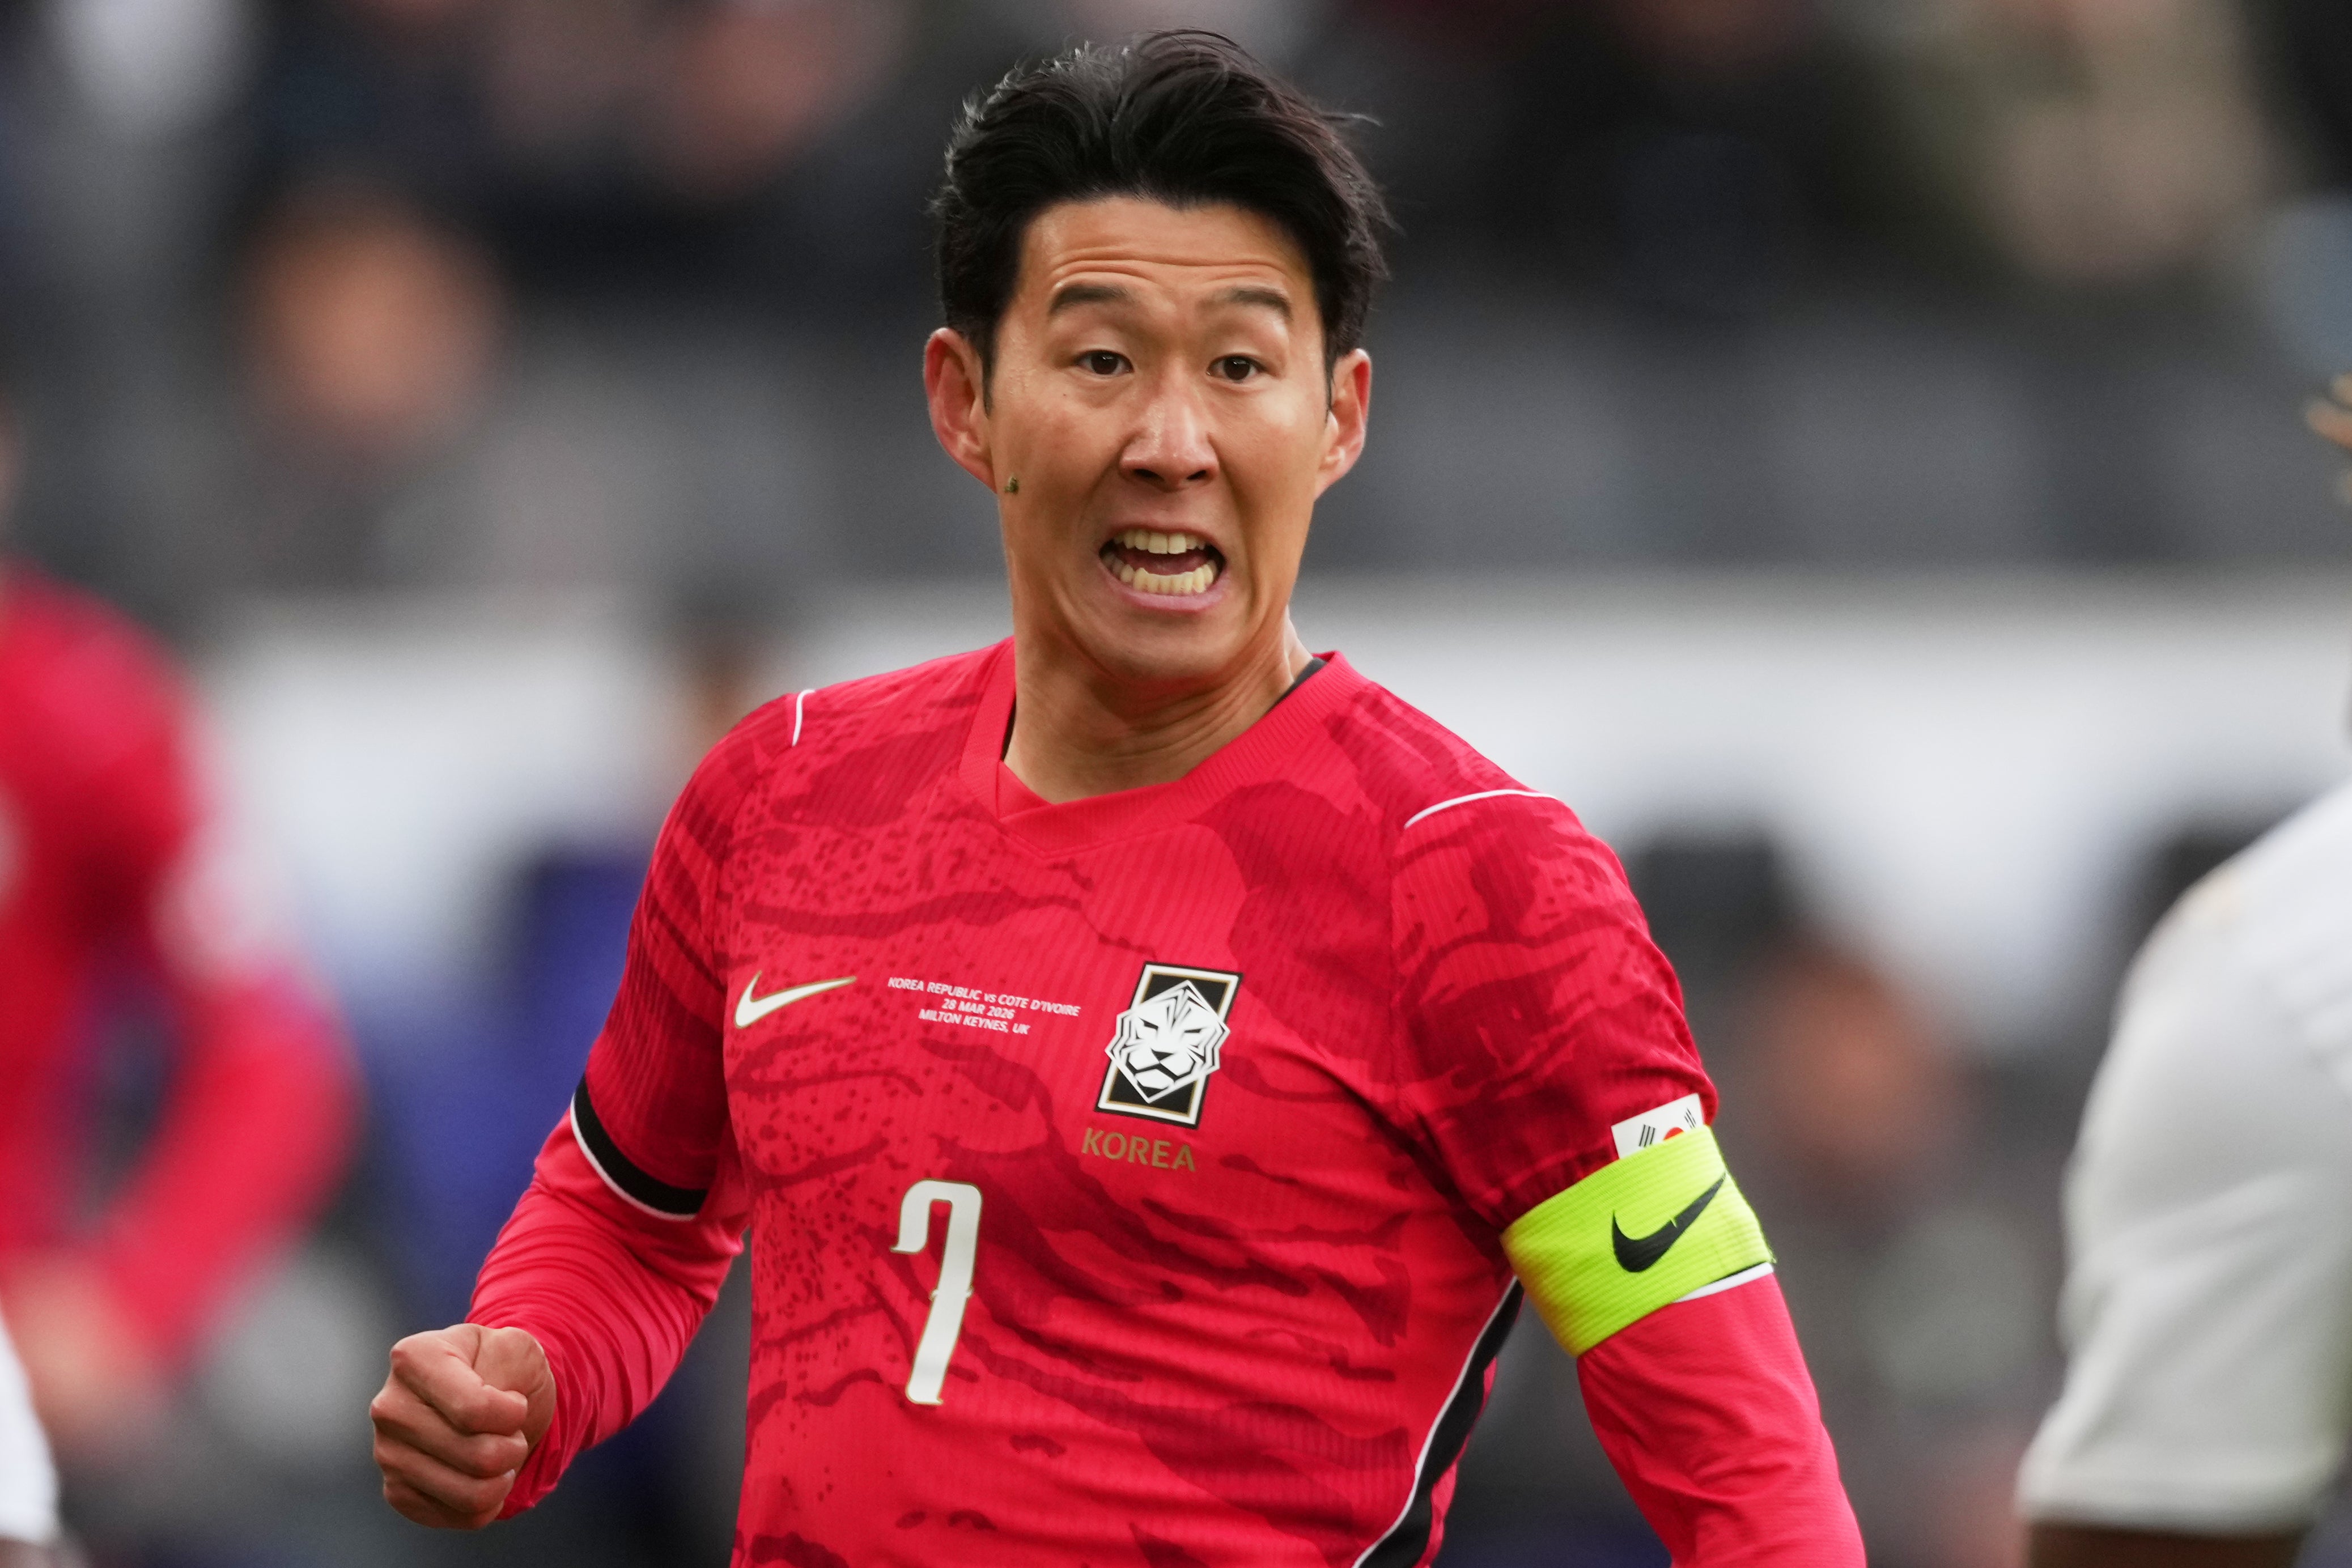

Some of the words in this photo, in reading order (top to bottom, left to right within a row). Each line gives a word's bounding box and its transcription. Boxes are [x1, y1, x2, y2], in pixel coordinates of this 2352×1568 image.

[888, 977, 924, 991] KOREA
[927, 981, 982, 1001] REPUBLIC
[997, 994, 1029, 1008] COTE
[1030, 1000, 1081, 1017] D'IVOIRE
[941, 998, 956, 1010] 28
[958, 1001, 985, 1014] MAR
[986, 1006, 1016, 1019] 2026
[918, 1009, 961, 1025] MILTON
[962, 1015, 1009, 1033] KEYNES,
[1012, 1023, 1030, 1035] UK
[1081, 1127, 1196, 1172] KOREA
[889, 1177, 983, 1406] 7
